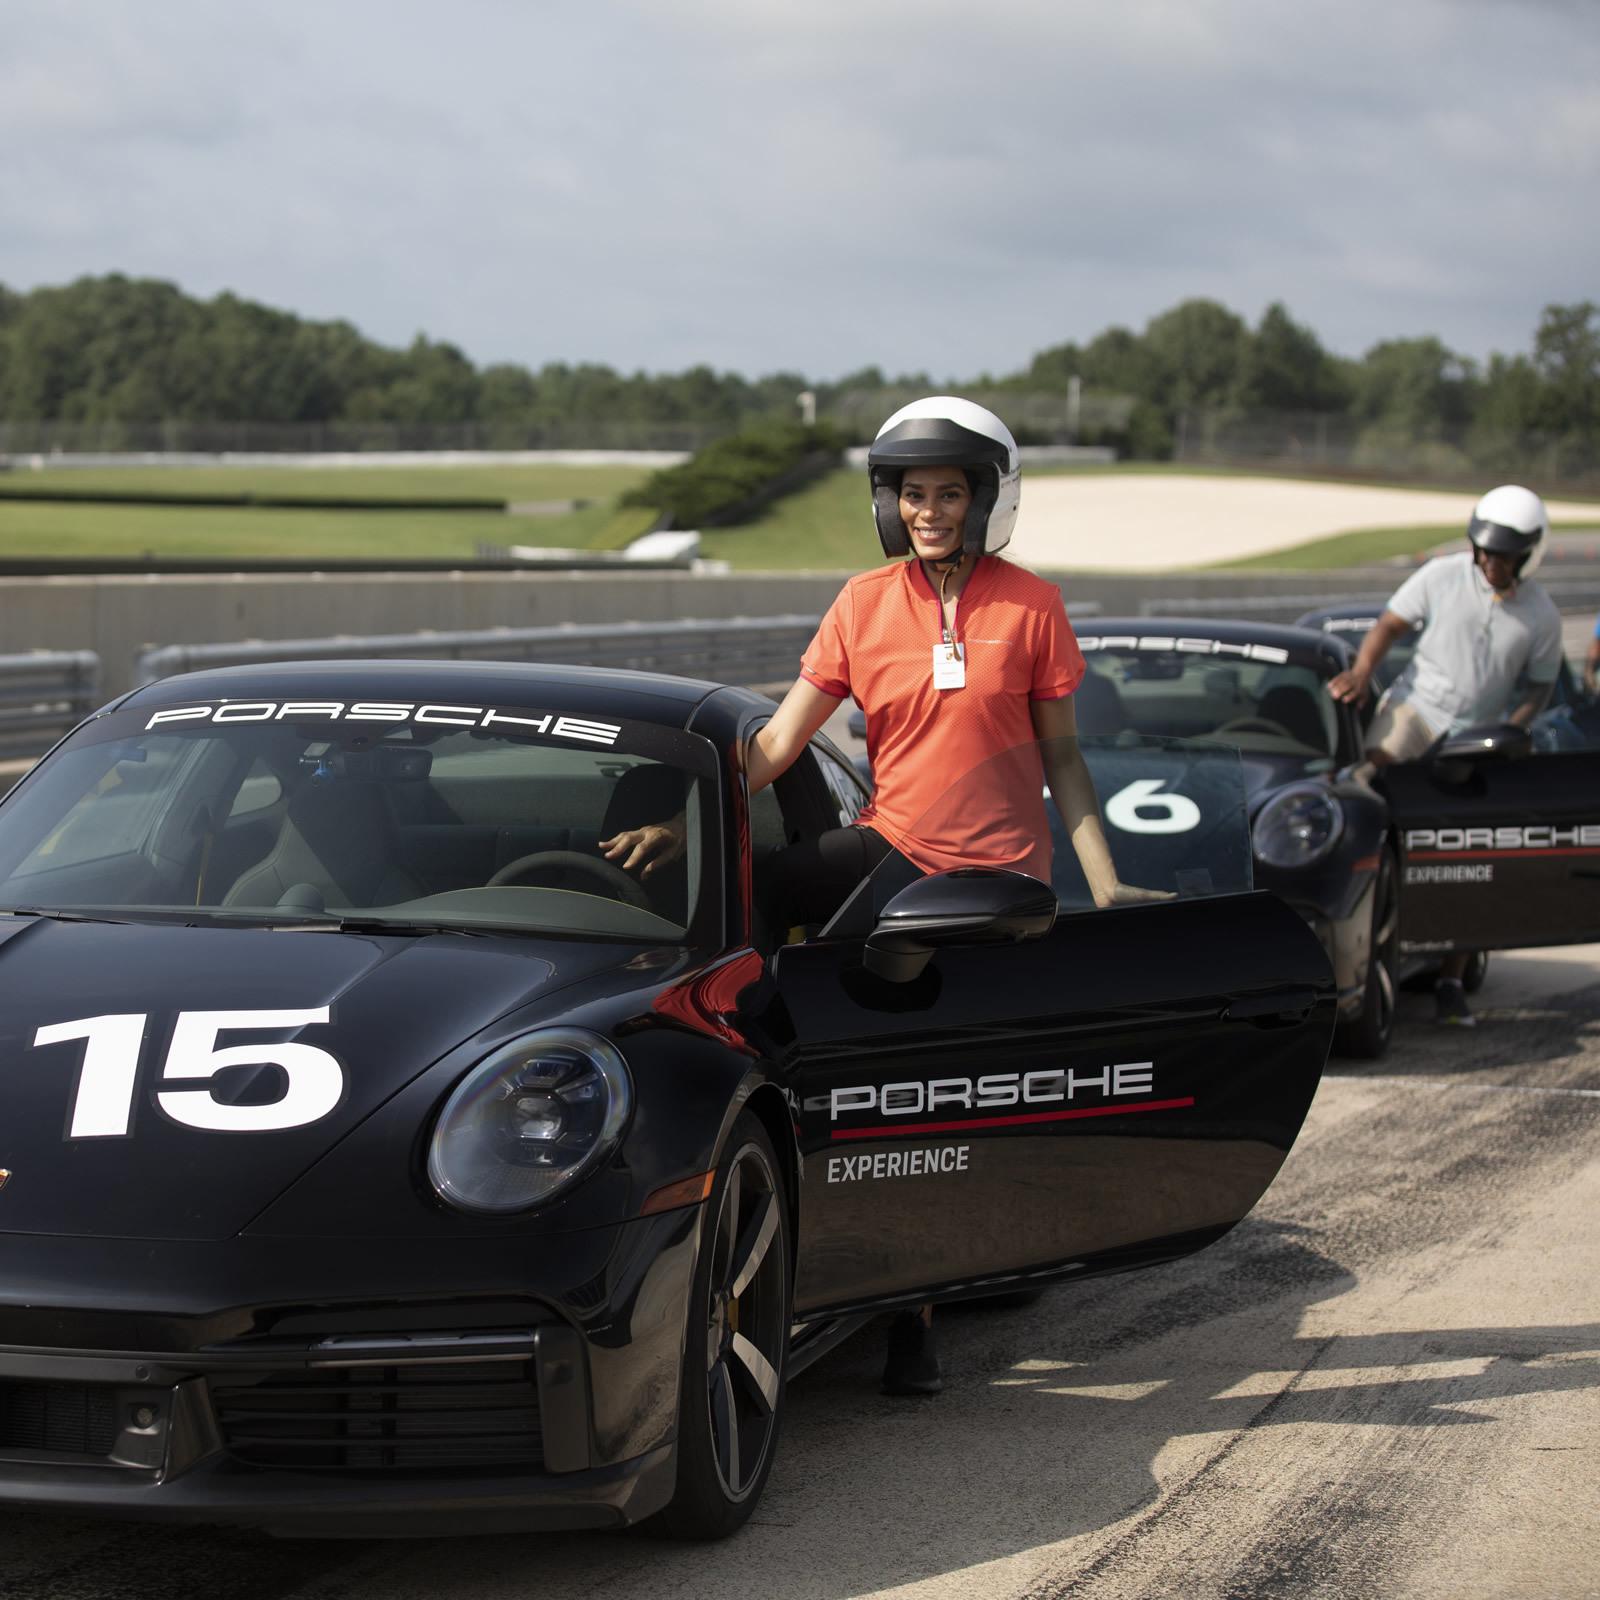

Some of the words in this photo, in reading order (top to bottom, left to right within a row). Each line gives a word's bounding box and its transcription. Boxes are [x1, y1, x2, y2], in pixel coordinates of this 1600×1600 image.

[1077, 636, 1288, 663] ORSCHE
[145, 699, 621, 745] PORSCHE
[1043, 780, 1201, 834] 6
[1406, 864, 1493, 884] EXPERIENCE
[33, 1005, 343, 1137] 15
[830, 1061, 1153, 1121] PORSCHE
[827, 1145, 970, 1183] EXPERIENCE
